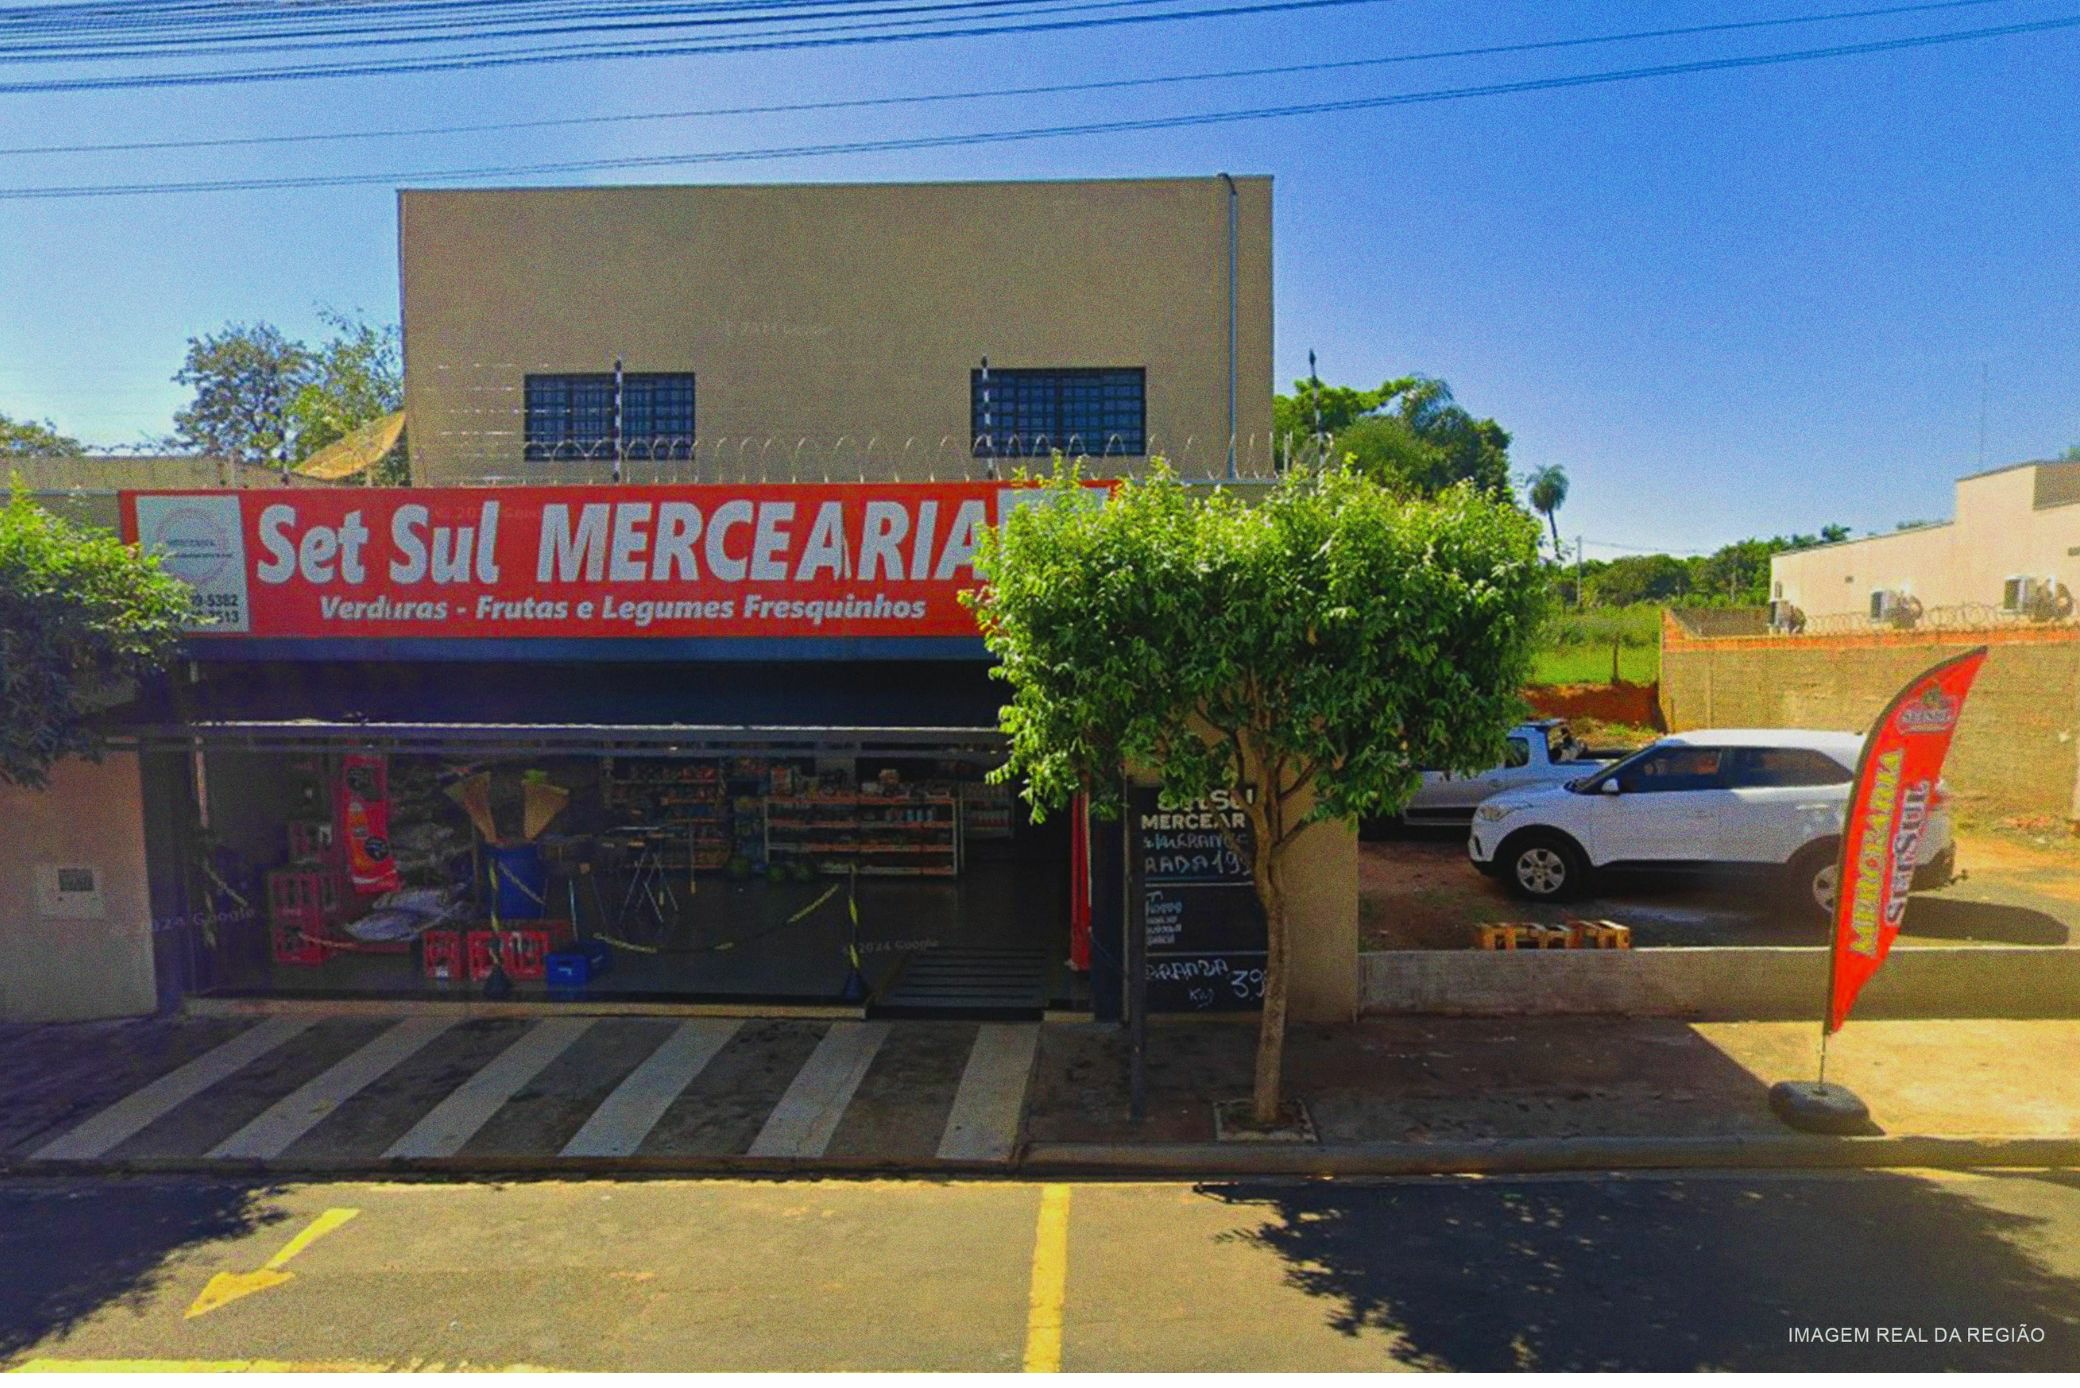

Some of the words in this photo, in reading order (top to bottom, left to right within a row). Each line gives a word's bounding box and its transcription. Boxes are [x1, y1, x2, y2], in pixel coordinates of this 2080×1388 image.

[256, 503, 369, 585] Set
[388, 500, 500, 585] Sul
[536, 499, 986, 583] MERCEARIA
[475, 596, 567, 621] Frutas
[576, 604, 593, 621] e
[602, 597, 735, 626] Legumes
[743, 594, 926, 626] Fresquinhos
[1851, 748, 1905, 957] MERCEARIA
